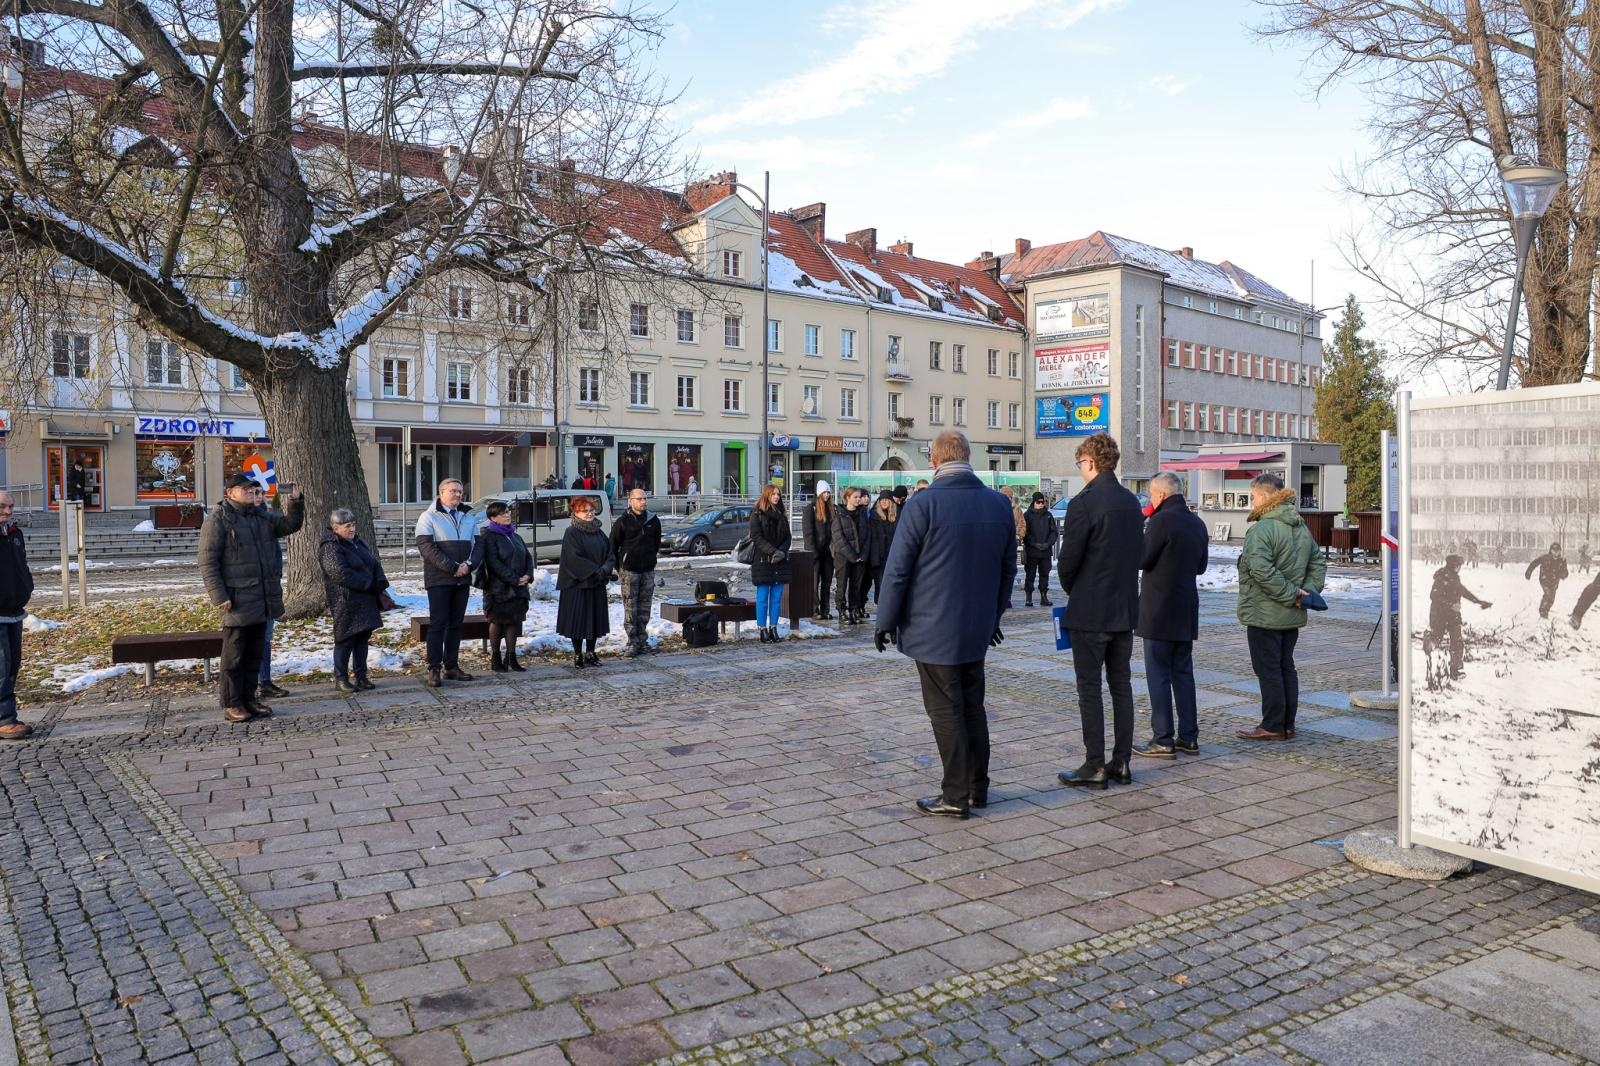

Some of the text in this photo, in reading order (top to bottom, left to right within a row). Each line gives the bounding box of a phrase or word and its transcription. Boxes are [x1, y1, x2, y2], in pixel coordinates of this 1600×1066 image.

[1039, 352, 1106, 365] ALEXANDER
[1039, 364, 1062, 372] MEBLE
[818, 439, 867, 449] FIRANY SZYCIE
